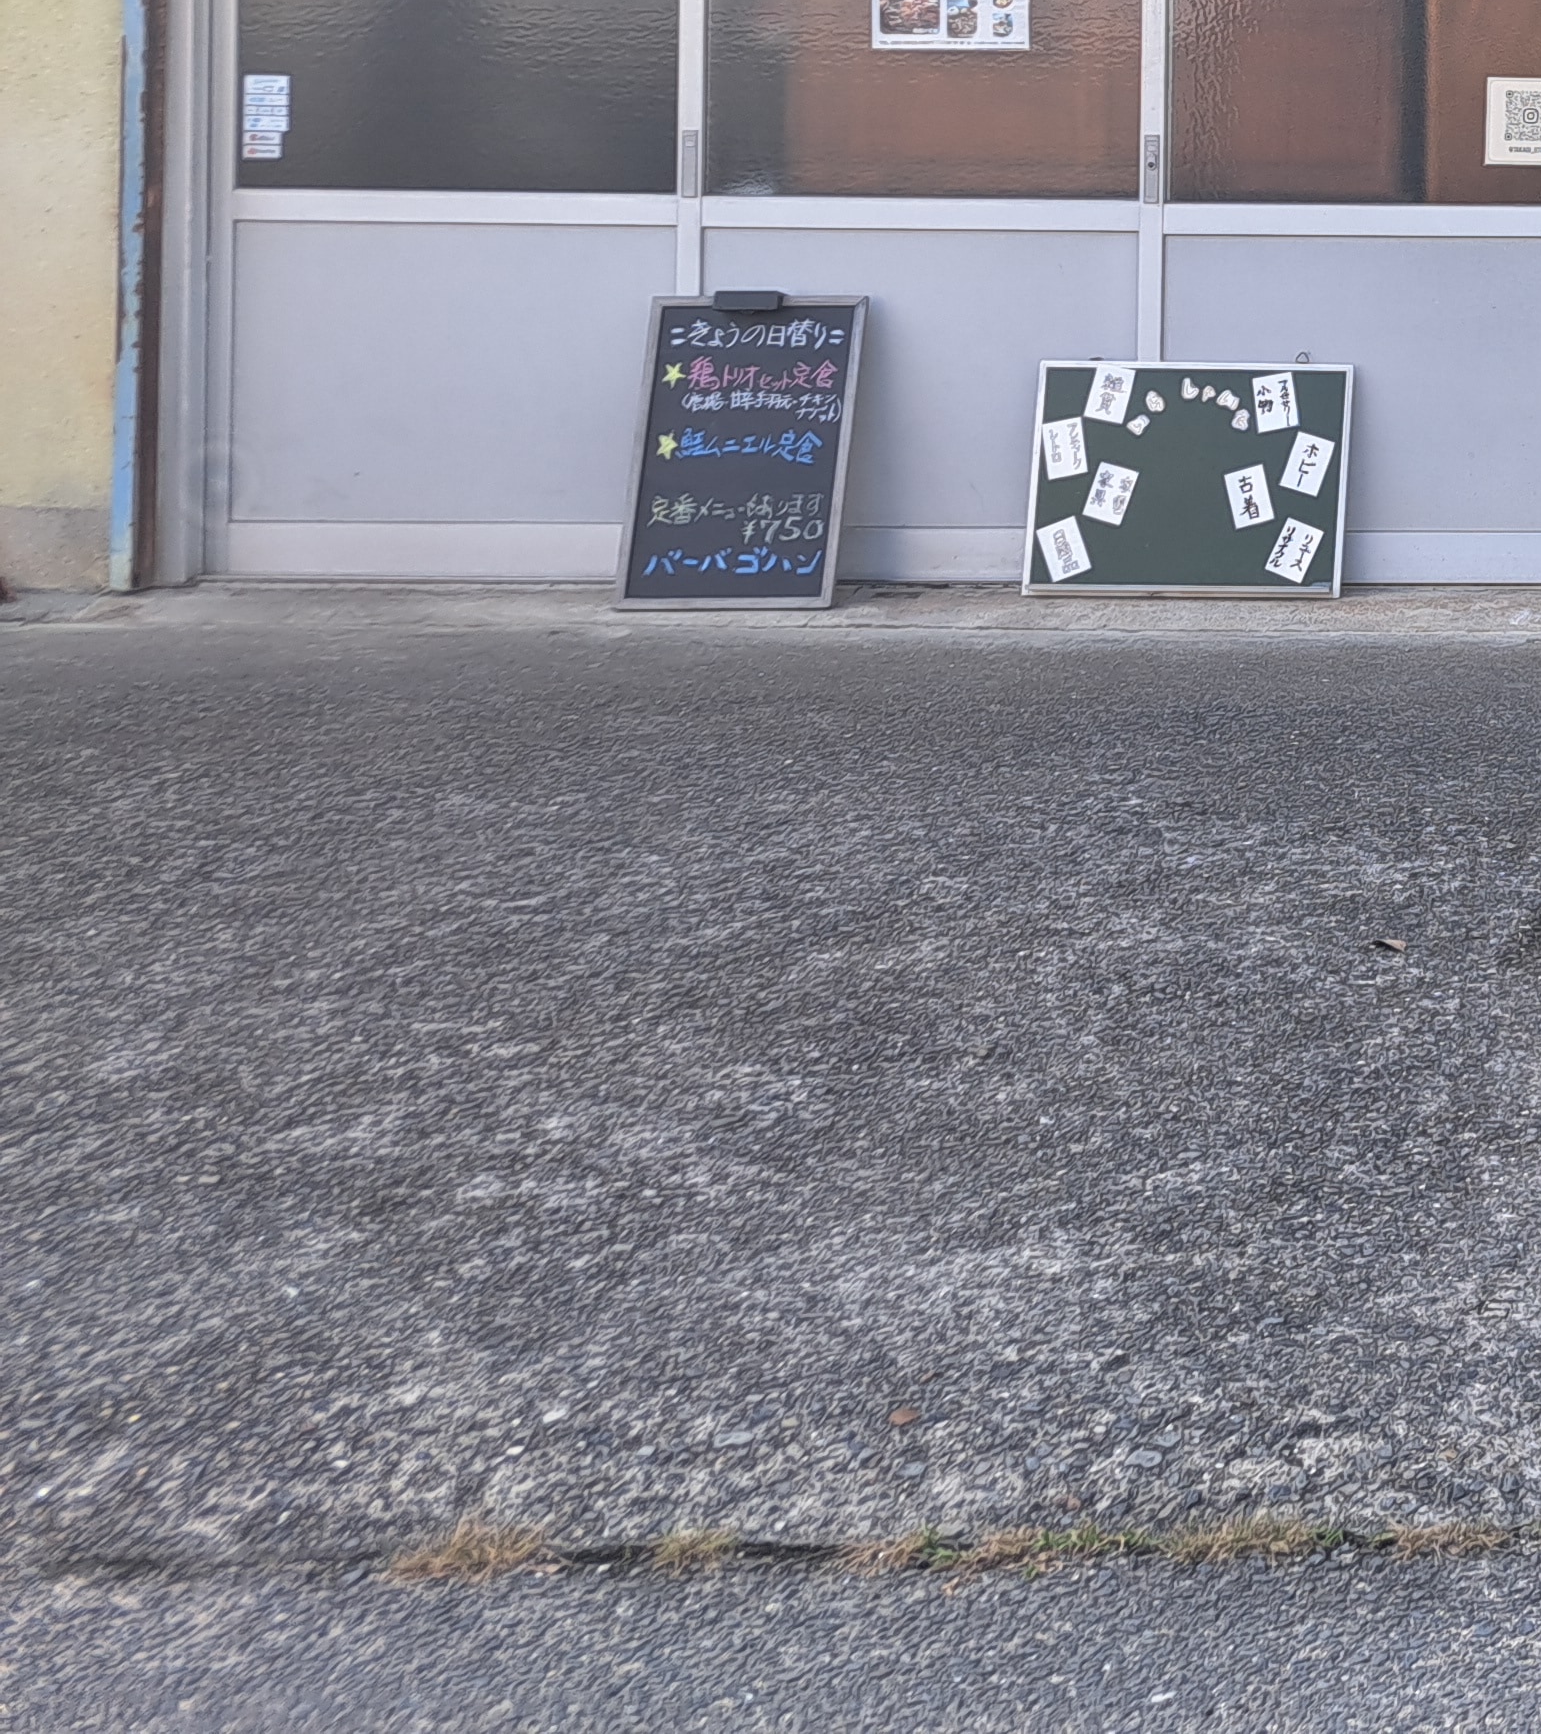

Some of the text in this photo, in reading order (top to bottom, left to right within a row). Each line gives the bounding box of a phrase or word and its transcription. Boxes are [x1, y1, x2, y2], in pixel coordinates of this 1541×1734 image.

[1256, 384, 1275, 415] 小物
[675, 427, 823, 464] 鮭ムニエル定食
[1048, 428, 1063, 464] レトロ
[1297, 442, 1320, 488] ホビー
[1089, 469, 1115, 507] 家具
[1237, 475, 1260, 520] 古着
[741, 515, 825, 545] ¥750
[643, 546, 823, 576] バーバゴハン
